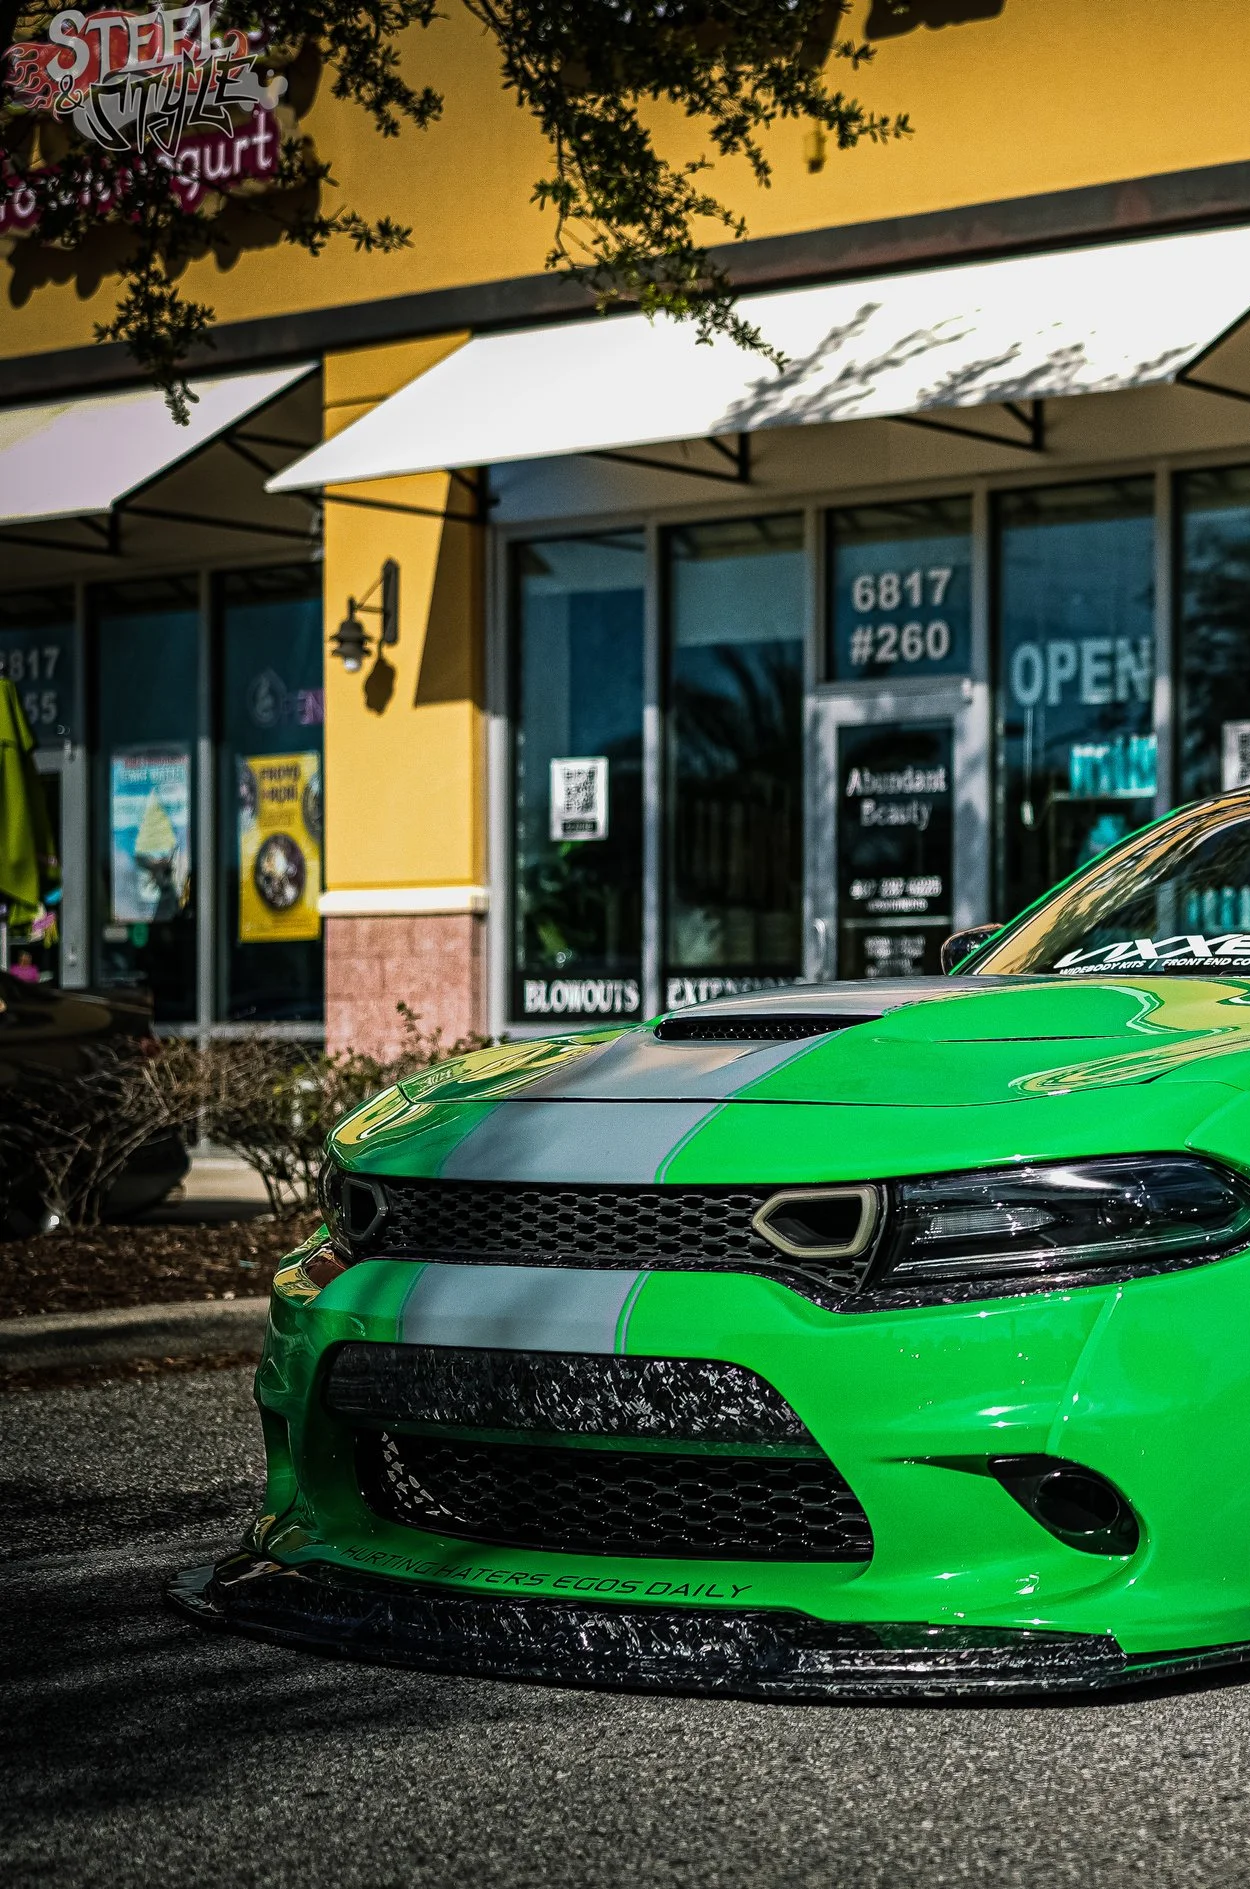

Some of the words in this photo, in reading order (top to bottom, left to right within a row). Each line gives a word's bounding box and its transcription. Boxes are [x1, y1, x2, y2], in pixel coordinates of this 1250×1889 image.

[852, 567, 952, 612] 6817
[0, 645, 61, 682] 817
[850, 620, 951, 665] #260
[1011, 636, 1151, 706] OPEN
[1059, 961, 1121, 975] WIDEBODY
[1118, 960, 1146, 969] KITS
[1162, 958, 1205, 966] FRONT
[1203, 957, 1232, 966] END
[523, 979, 640, 1013] BLOWOUTS
[339, 1545, 439, 1575] HURTING
[433, 1565, 551, 1586] HATERS
[552, 1575, 644, 1594] EGOS
[644, 1581, 753, 1599] DAILY
